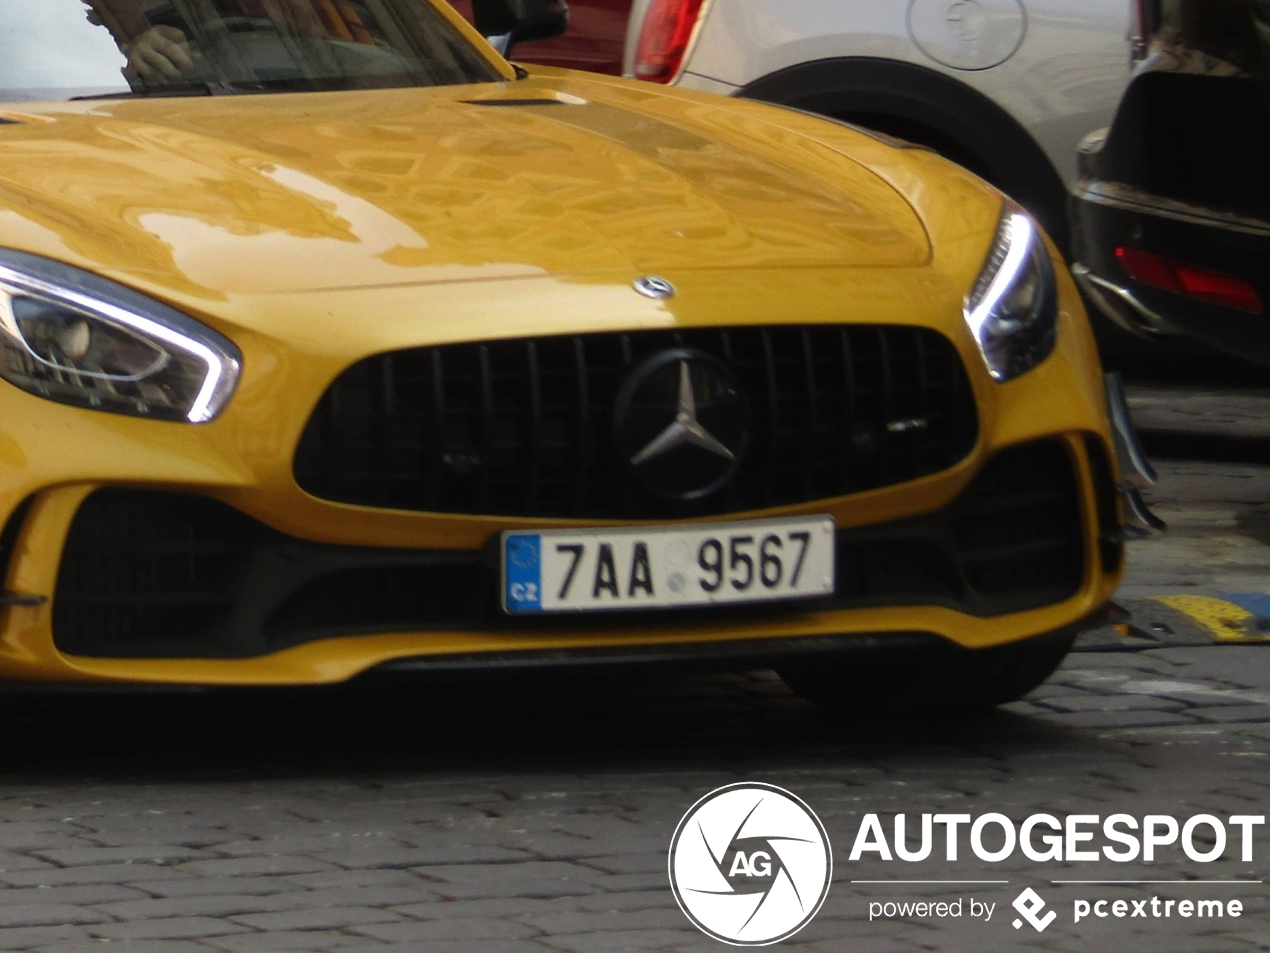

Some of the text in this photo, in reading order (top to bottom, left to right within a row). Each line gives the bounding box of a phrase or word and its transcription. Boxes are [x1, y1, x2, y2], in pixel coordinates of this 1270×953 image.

[556, 532, 811, 599] 7AA 9567
[511, 582, 538, 601] CZ
